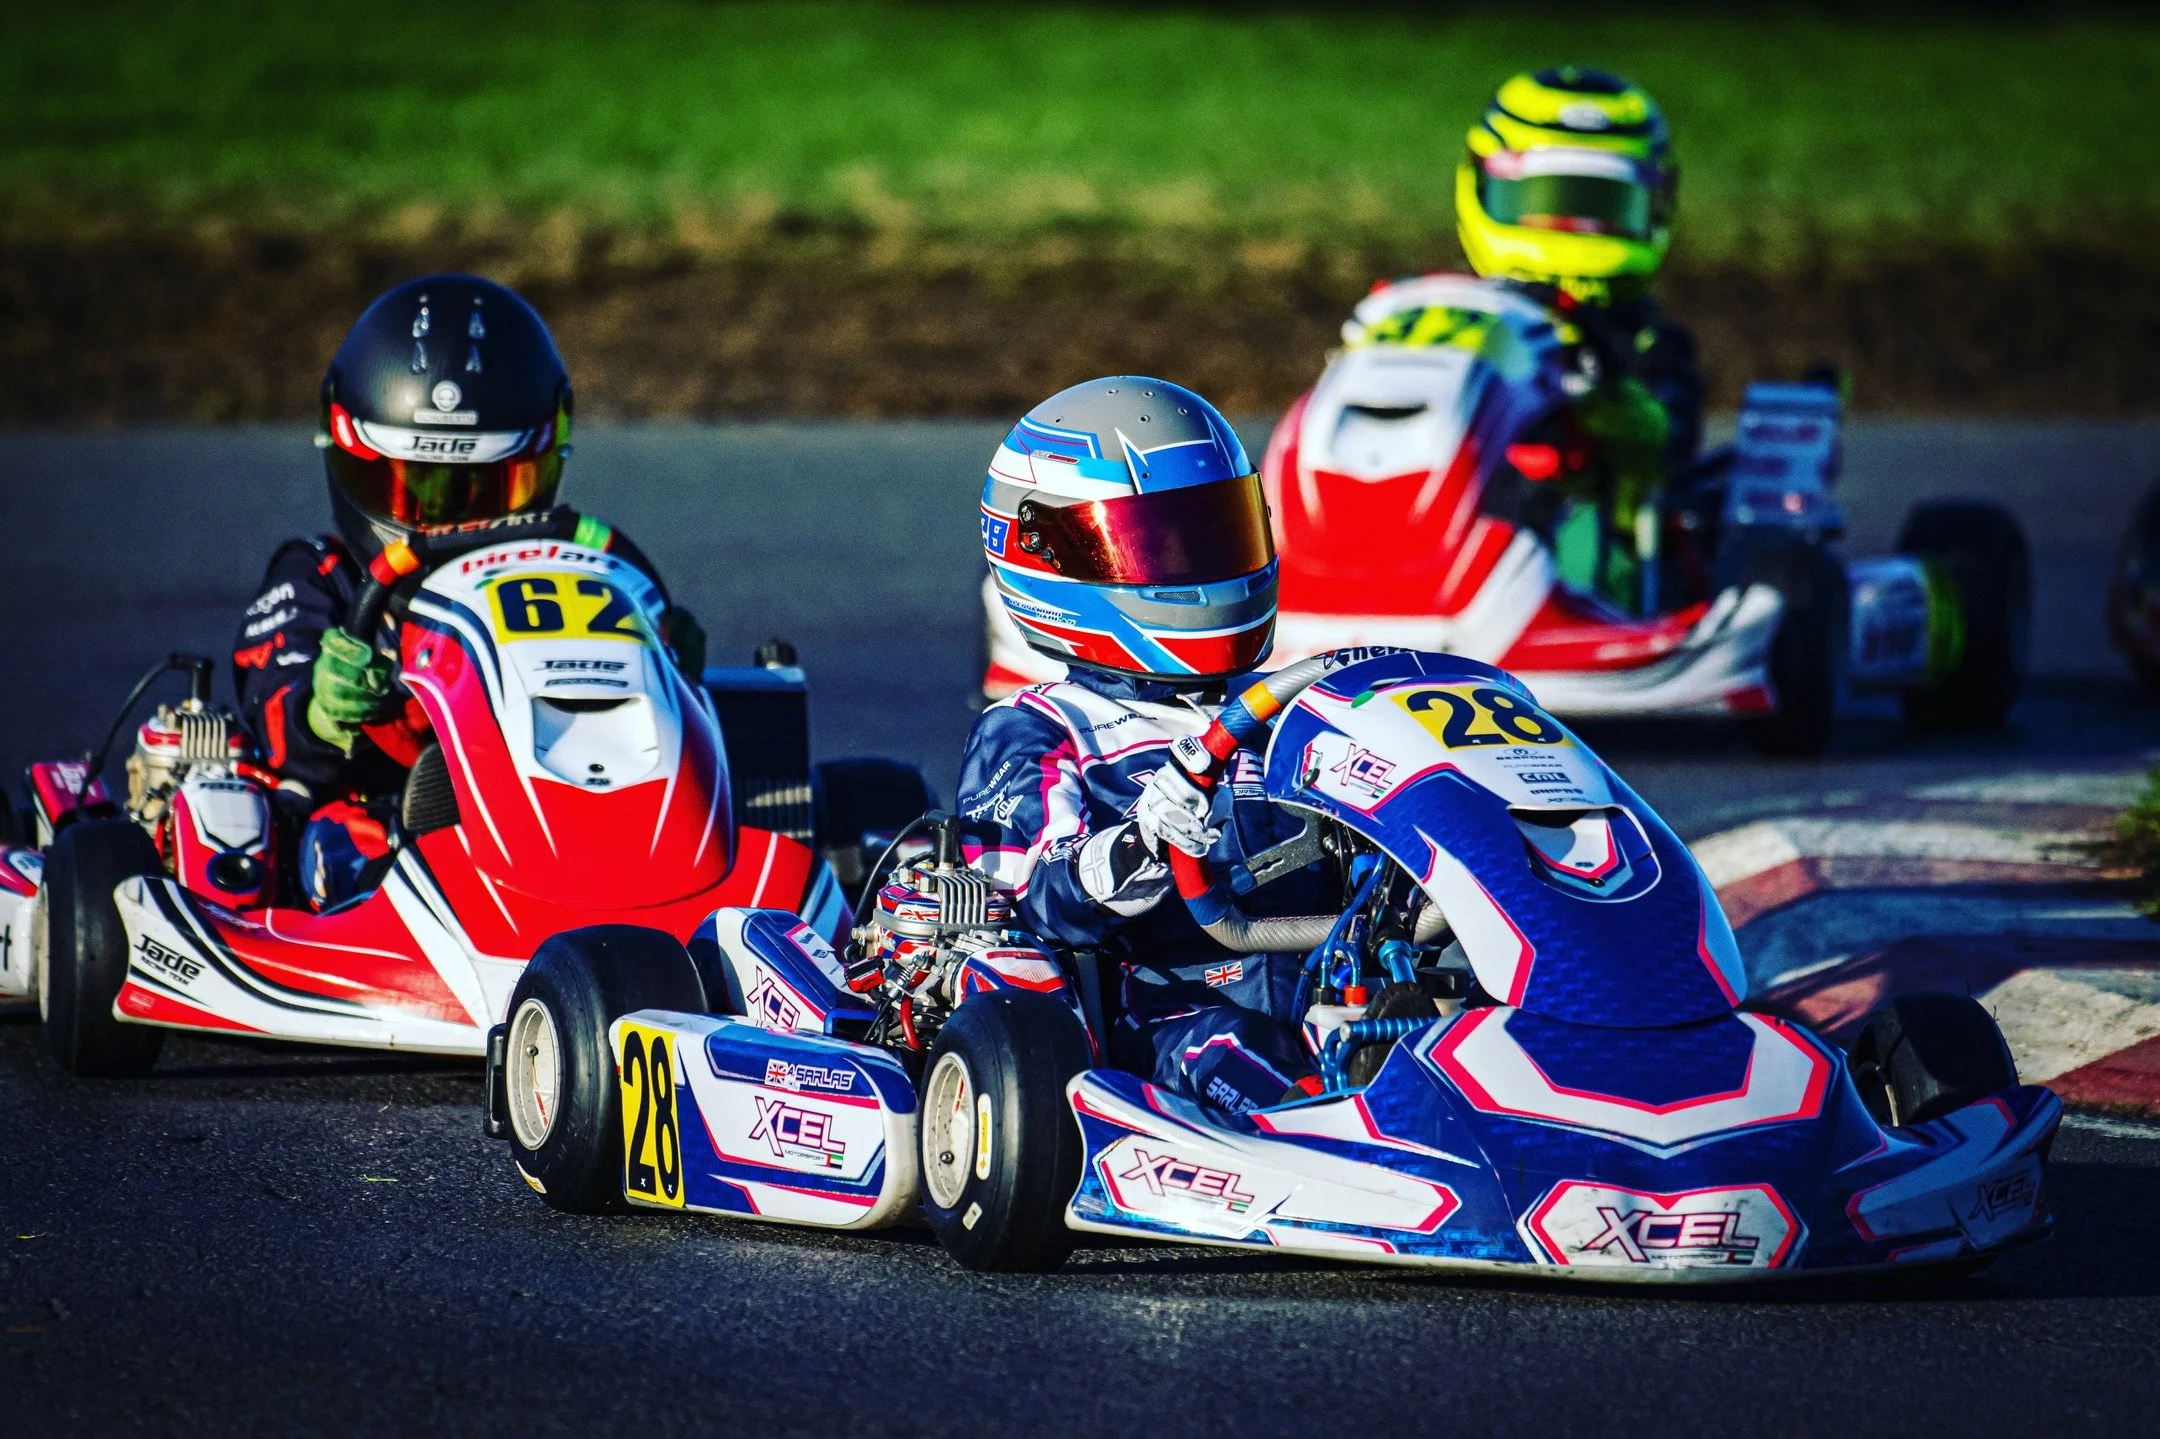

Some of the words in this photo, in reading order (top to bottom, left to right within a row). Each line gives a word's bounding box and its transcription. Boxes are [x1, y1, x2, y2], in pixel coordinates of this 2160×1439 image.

[404, 436, 480, 454] Jade
[497, 578, 647, 641] 62
[532, 660, 629, 672] Jade
[1406, 688, 1564, 748] 28
[1180, 738, 1197, 757] OMP
[1330, 743, 1397, 790] XCEL
[962, 760, 1012, 804] PUREWEAR
[133, 933, 205, 980] Jade
[795, 1067, 852, 1088] SARLAS
[623, 1030, 680, 1200] 28
[748, 1096, 846, 1158] XCEL
[784, 1149, 825, 1162] MOTORSPORT
[1119, 1147, 1255, 1204] XCEL
[1580, 1206, 1760, 1263] XCEL
